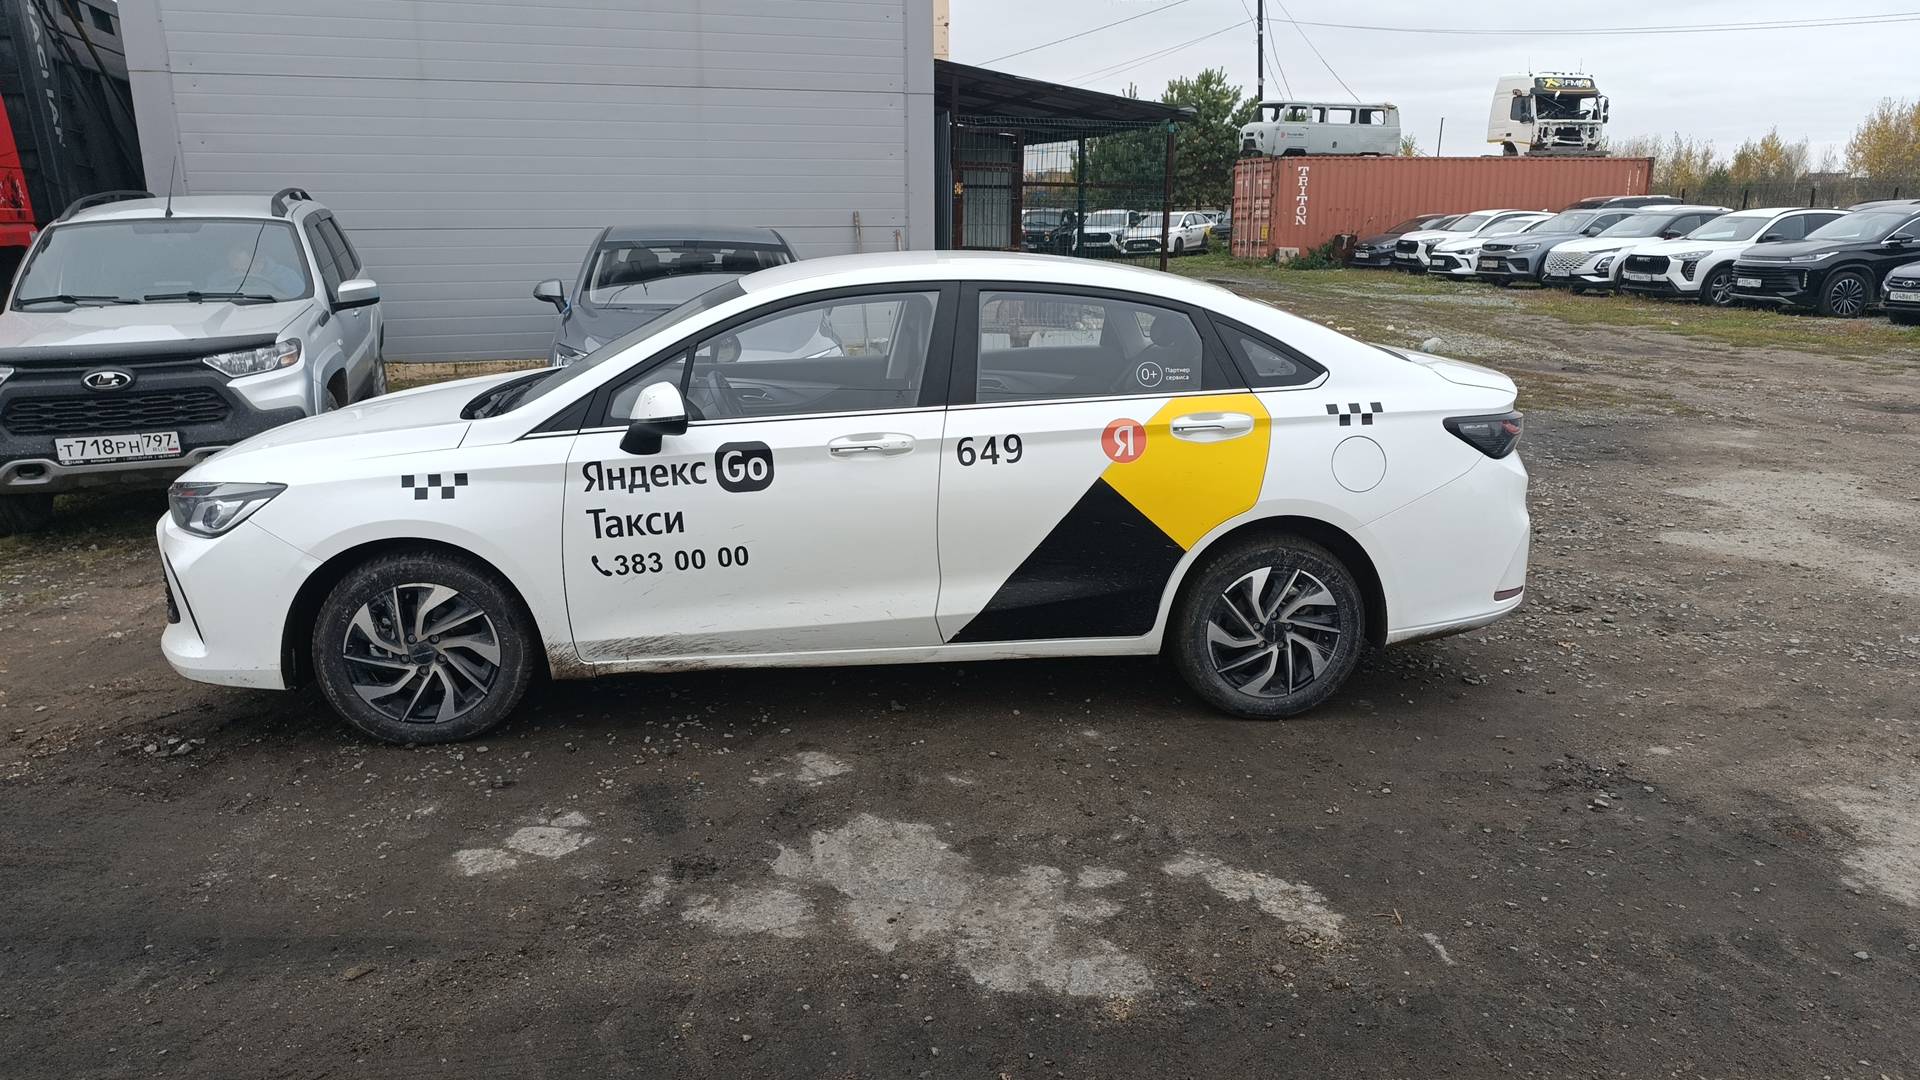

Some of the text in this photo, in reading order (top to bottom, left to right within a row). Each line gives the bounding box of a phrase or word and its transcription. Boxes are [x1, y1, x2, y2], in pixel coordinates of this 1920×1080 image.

[1295, 166, 1310, 225] TRITON
[1141, 368, 1157, 381] 0+
[142, 434, 172, 448] 797
[956, 433, 1023, 467] 649
[1113, 425, 1135, 456] Я
[582, 450, 768, 493] Яндекс Go
[585, 508, 685, 540] Такси
[614, 545, 749, 576] 383 00 00
